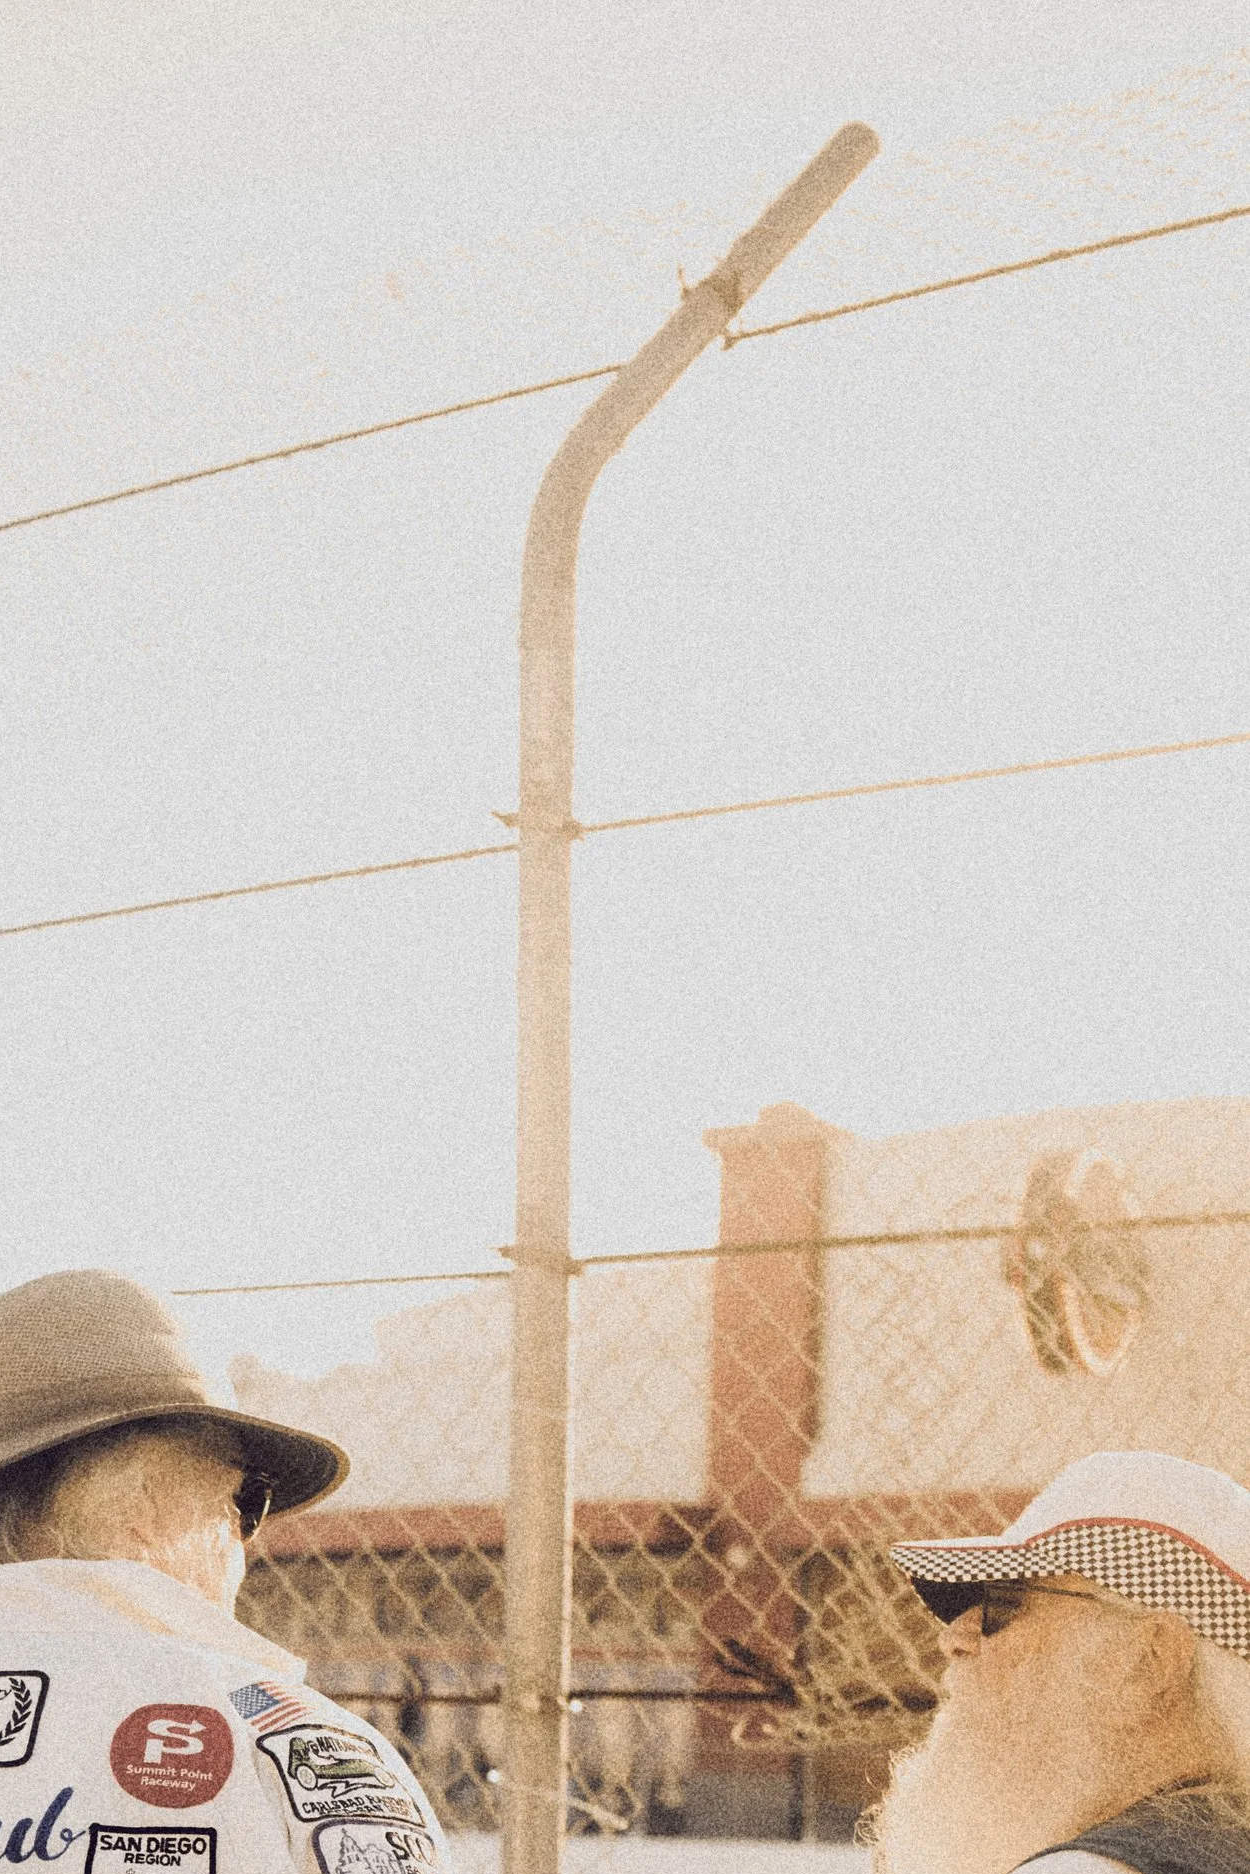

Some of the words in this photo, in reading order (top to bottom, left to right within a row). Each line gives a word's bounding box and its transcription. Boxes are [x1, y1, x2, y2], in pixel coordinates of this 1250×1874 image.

[126, 1764, 177, 1776] Summit
[180, 1769, 213, 1781] Point
[140, 1777, 196, 1791] Raceway
[100, 1835, 142, 1852] SAN
[146, 1837, 207, 1855] DIEGO
[124, 1853, 181, 1866] REGION
